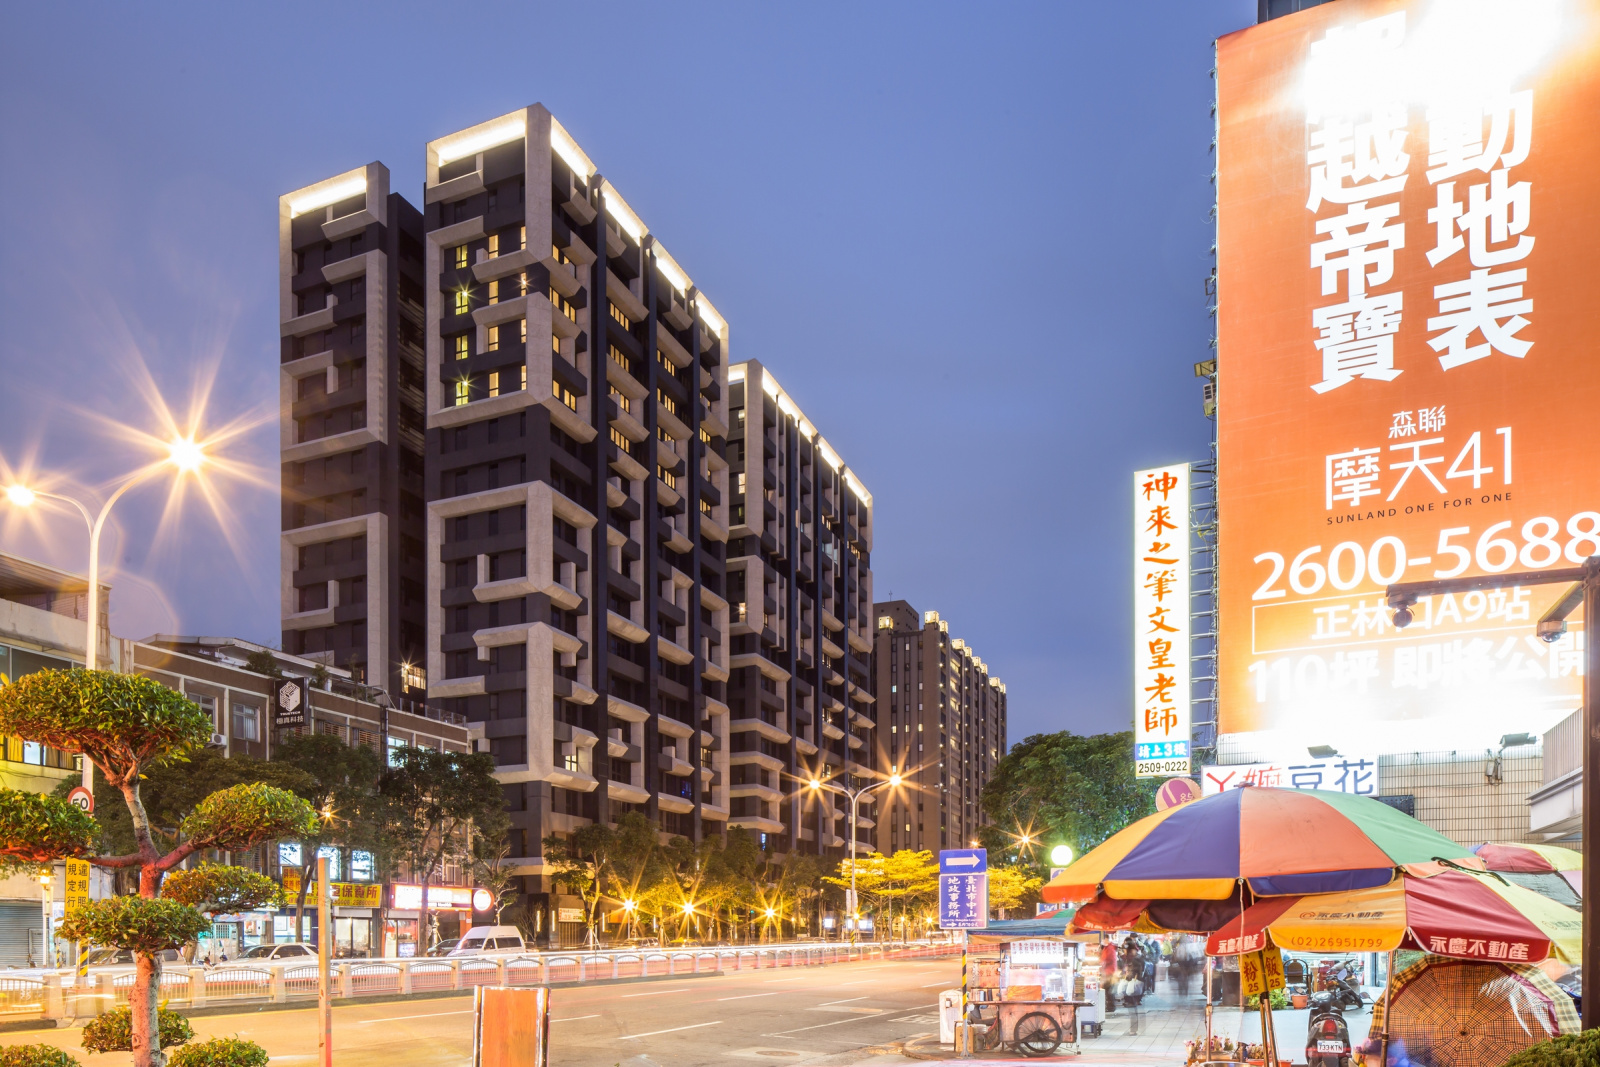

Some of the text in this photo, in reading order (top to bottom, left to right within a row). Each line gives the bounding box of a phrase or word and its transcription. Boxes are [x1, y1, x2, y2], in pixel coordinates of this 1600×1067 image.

[1388, 405, 1446, 438] 森聯
[1326, 426, 1512, 510] 摩天41
[1326, 492, 1512, 526] SUNLAND ONE FOR ONE
[1252, 511, 1600, 600] 2600-5688
[1142, 472, 1181, 736] 神來之筆文皇老師
[1138, 760, 1188, 774] 2509-0222
[72, 797, 89, 810] 50
[66, 863, 78, 918] 規定行
[948, 876, 961, 918] 地政事務所
[1291, 936, 1383, 948] (02)26951799
[1430, 935, 1530, 960] 永慶不動產
[1248, 983, 1259, 993] 25
[1270, 978, 1281, 988] 25
